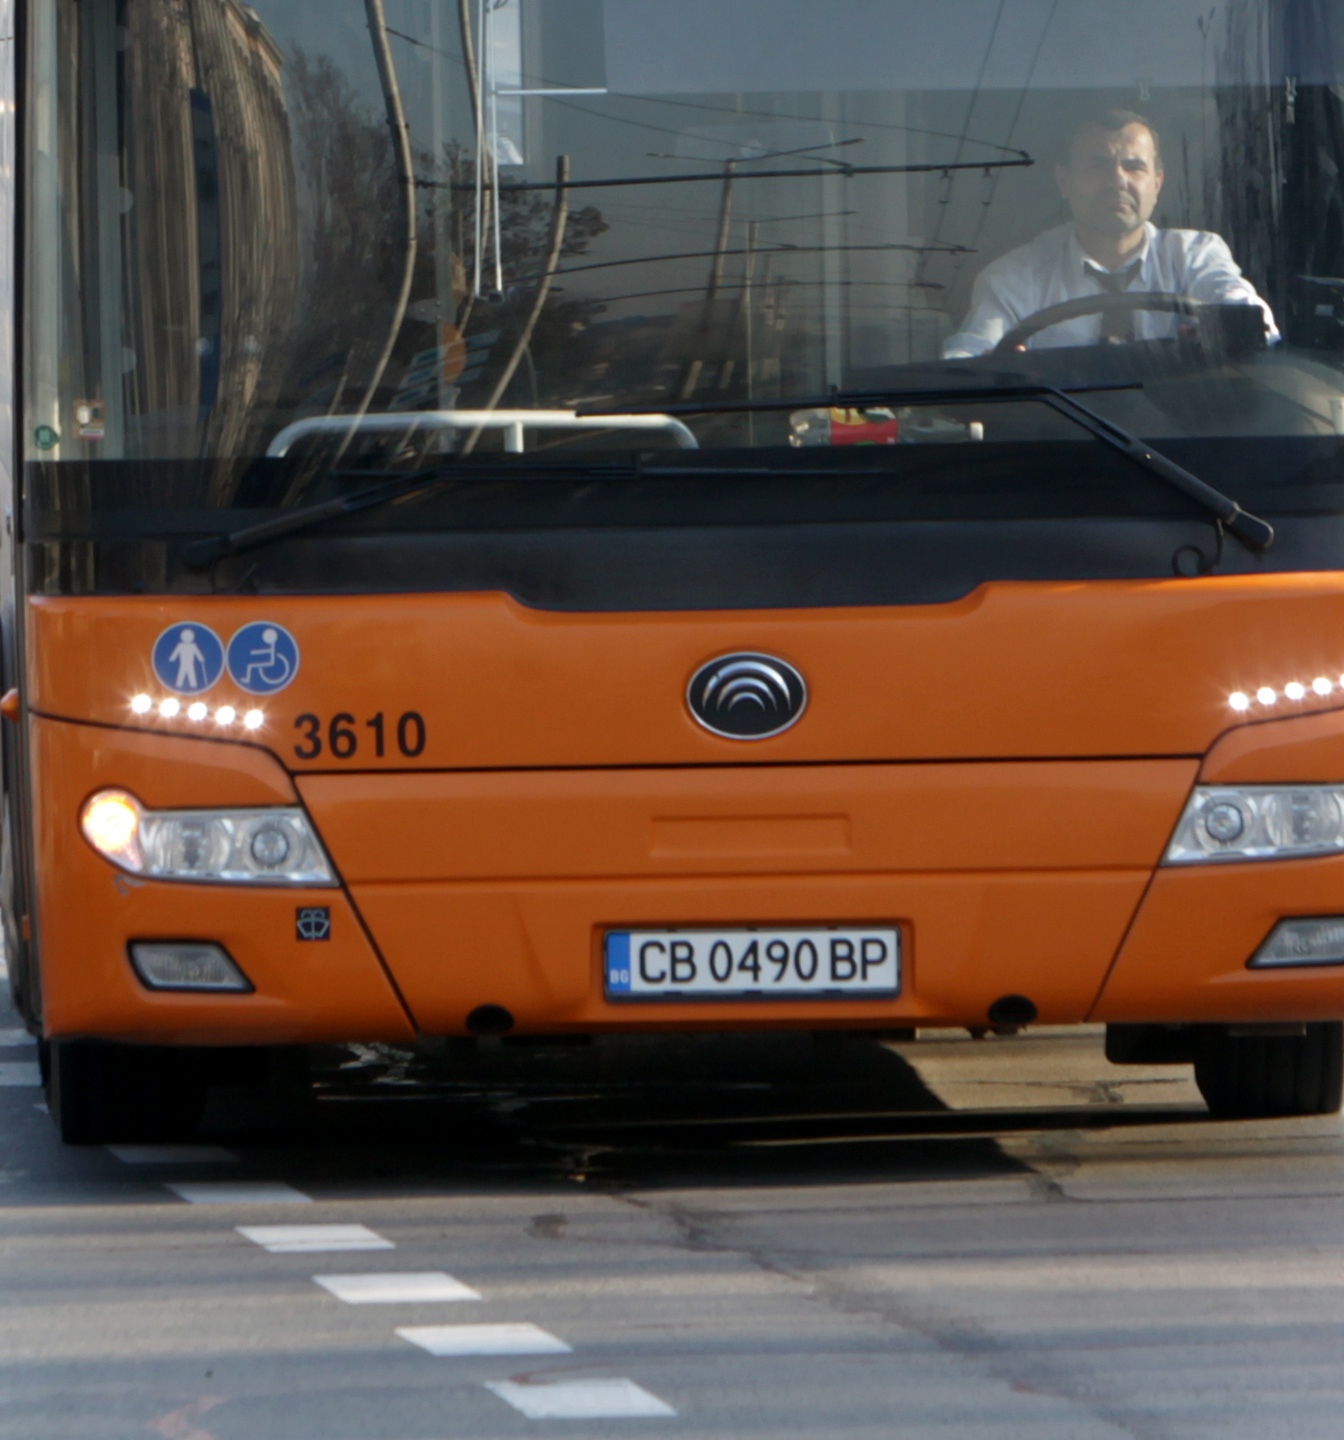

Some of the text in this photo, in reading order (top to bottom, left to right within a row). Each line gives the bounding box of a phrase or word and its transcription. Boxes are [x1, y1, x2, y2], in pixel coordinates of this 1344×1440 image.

[293, 710, 427, 760] 3610
[609, 969, 630, 984] BG
[708, 938, 819, 983] 0490
